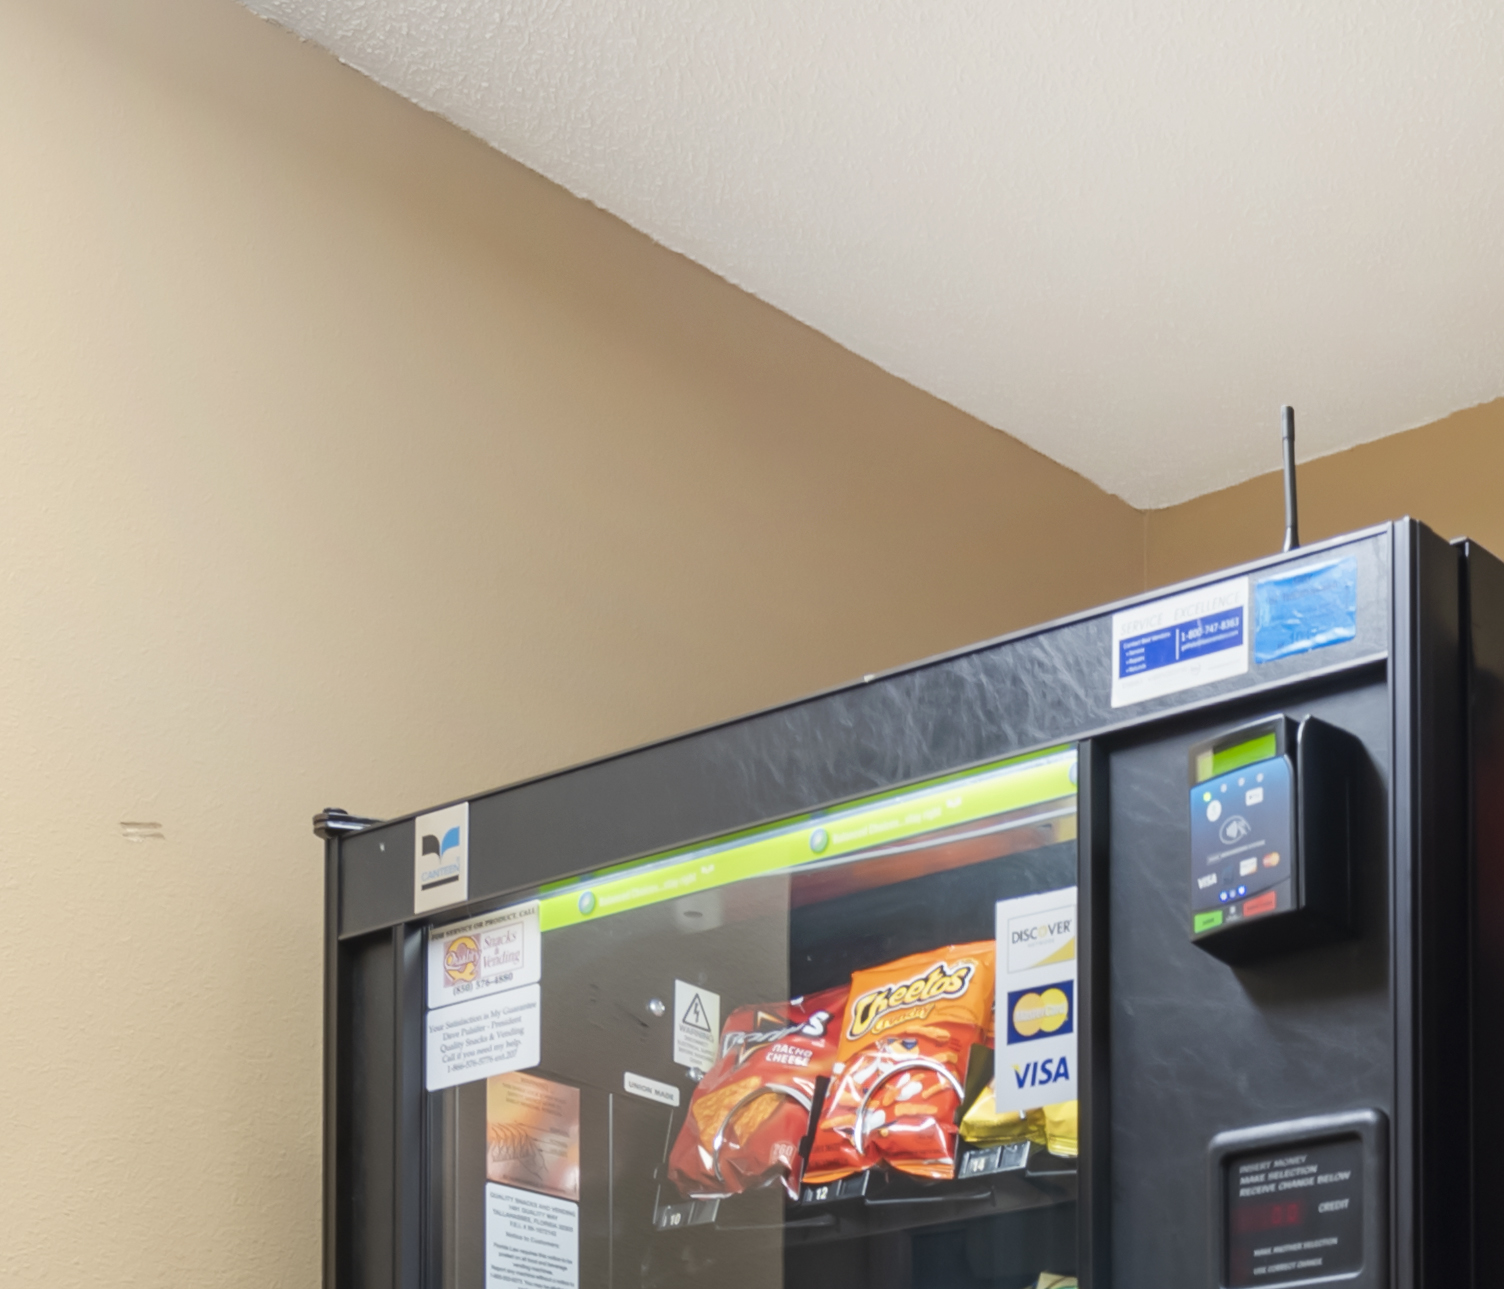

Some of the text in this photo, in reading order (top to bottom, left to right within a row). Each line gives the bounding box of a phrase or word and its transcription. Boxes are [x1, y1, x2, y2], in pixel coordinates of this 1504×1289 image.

[421, 864, 460, 882] CANTEEN
[484, 930, 517, 948] Snacks
[1011, 920, 1073, 944] DISCOVER
[483, 950, 521, 969] Vending
[850, 966, 973, 1039] Cheetos
[1011, 1057, 1070, 1089] VISA
[628, 1080, 675, 1101] UNION MADE
[972, 1159, 984, 1172] 14
[1267, 1164, 1319, 1181] SELECTION
[1317, 1170, 1352, 1184] BELOW
[815, 1187, 828, 1199] 12
[1318, 1198, 1350, 1213] CREDIT
[670, 1213, 682, 1225] 10
